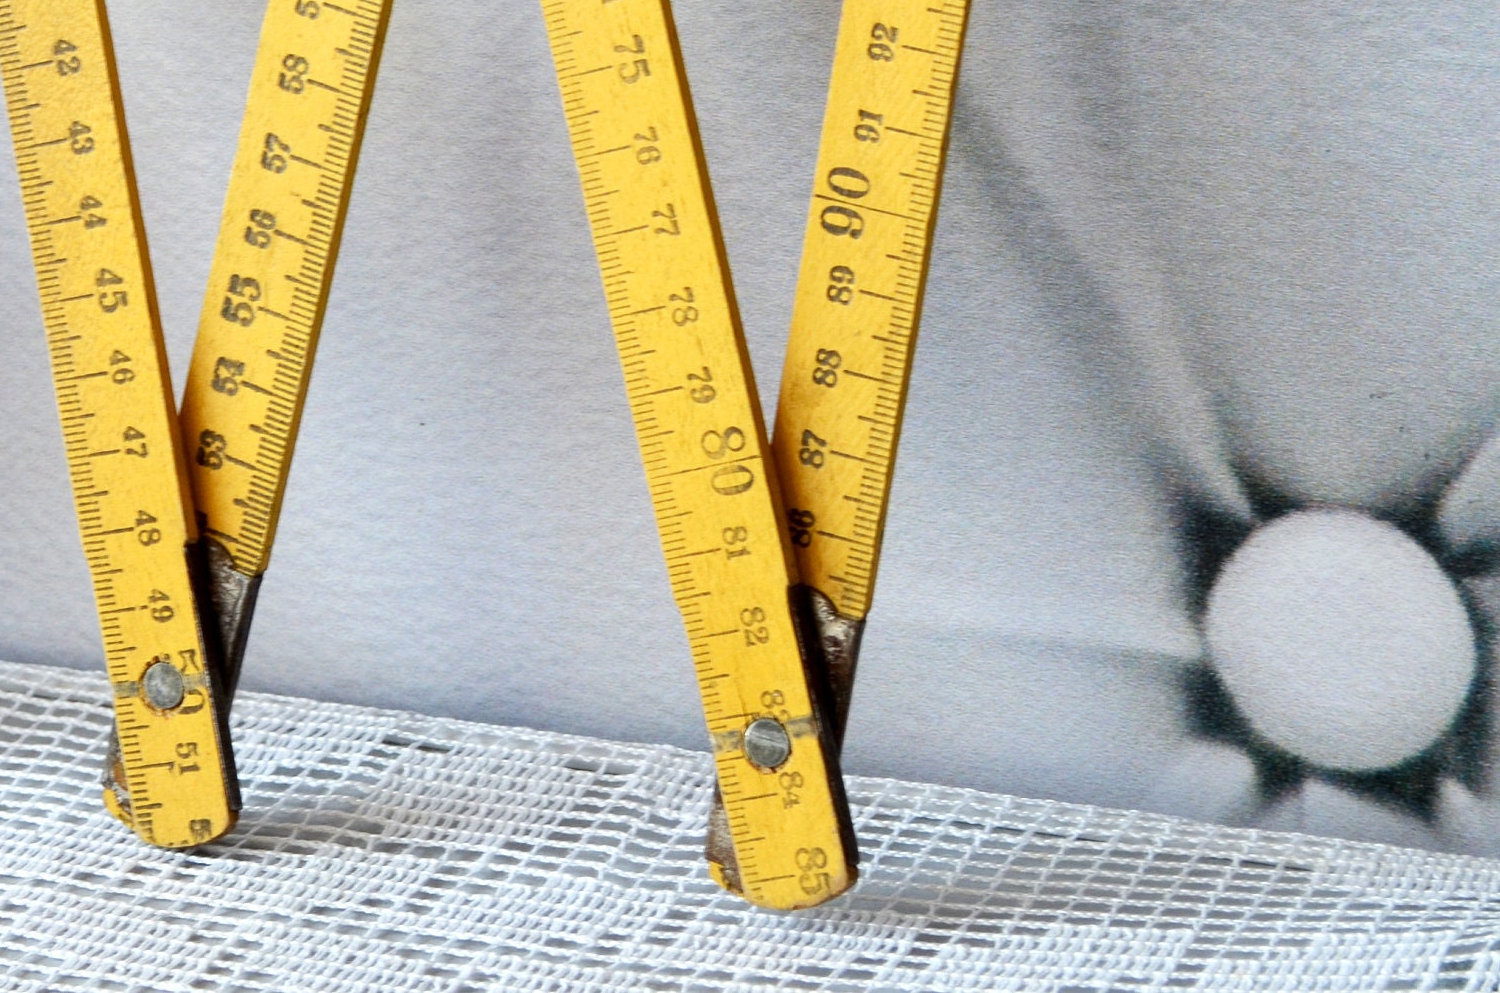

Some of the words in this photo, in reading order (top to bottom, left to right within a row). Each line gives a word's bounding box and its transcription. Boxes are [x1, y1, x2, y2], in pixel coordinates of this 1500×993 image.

[51, 37, 81, 77] 42
[612, 32, 651, 84] 75
[865, 20, 899, 62] 92
[276, 52, 309, 95] 58
[66, 119, 95, 156] 43
[632, 124, 662, 166] 76
[852, 107, 883, 143] 91
[258, 131, 291, 174] 57
[78, 193, 108, 230] 44
[650, 201, 681, 236] 77
[818, 165, 870, 240] 90
[242, 207, 276, 249] 56
[93, 266, 129, 314] 45
[218, 272, 262, 327] 55
[667, 285, 699, 327] 78
[824, 264, 855, 306] 89
[108, 348, 136, 385] 46
[208, 355, 245, 397] 54
[685, 364, 717, 404] 79
[810, 346, 842, 389] 88
[121, 424, 149, 459] 47
[191, 427, 224, 470] 53
[699, 424, 755, 496] 80
[794, 427, 827, 470] 87
[134, 508, 162, 547] 48
[721, 524, 752, 561] 81
[783, 504, 812, 550] 86
[147, 587, 175, 624] 49
[738, 605, 770, 648] 82
[175, 740, 201, 775] 51
[777, 769, 805, 810] 84
[794, 845, 835, 897] 85
